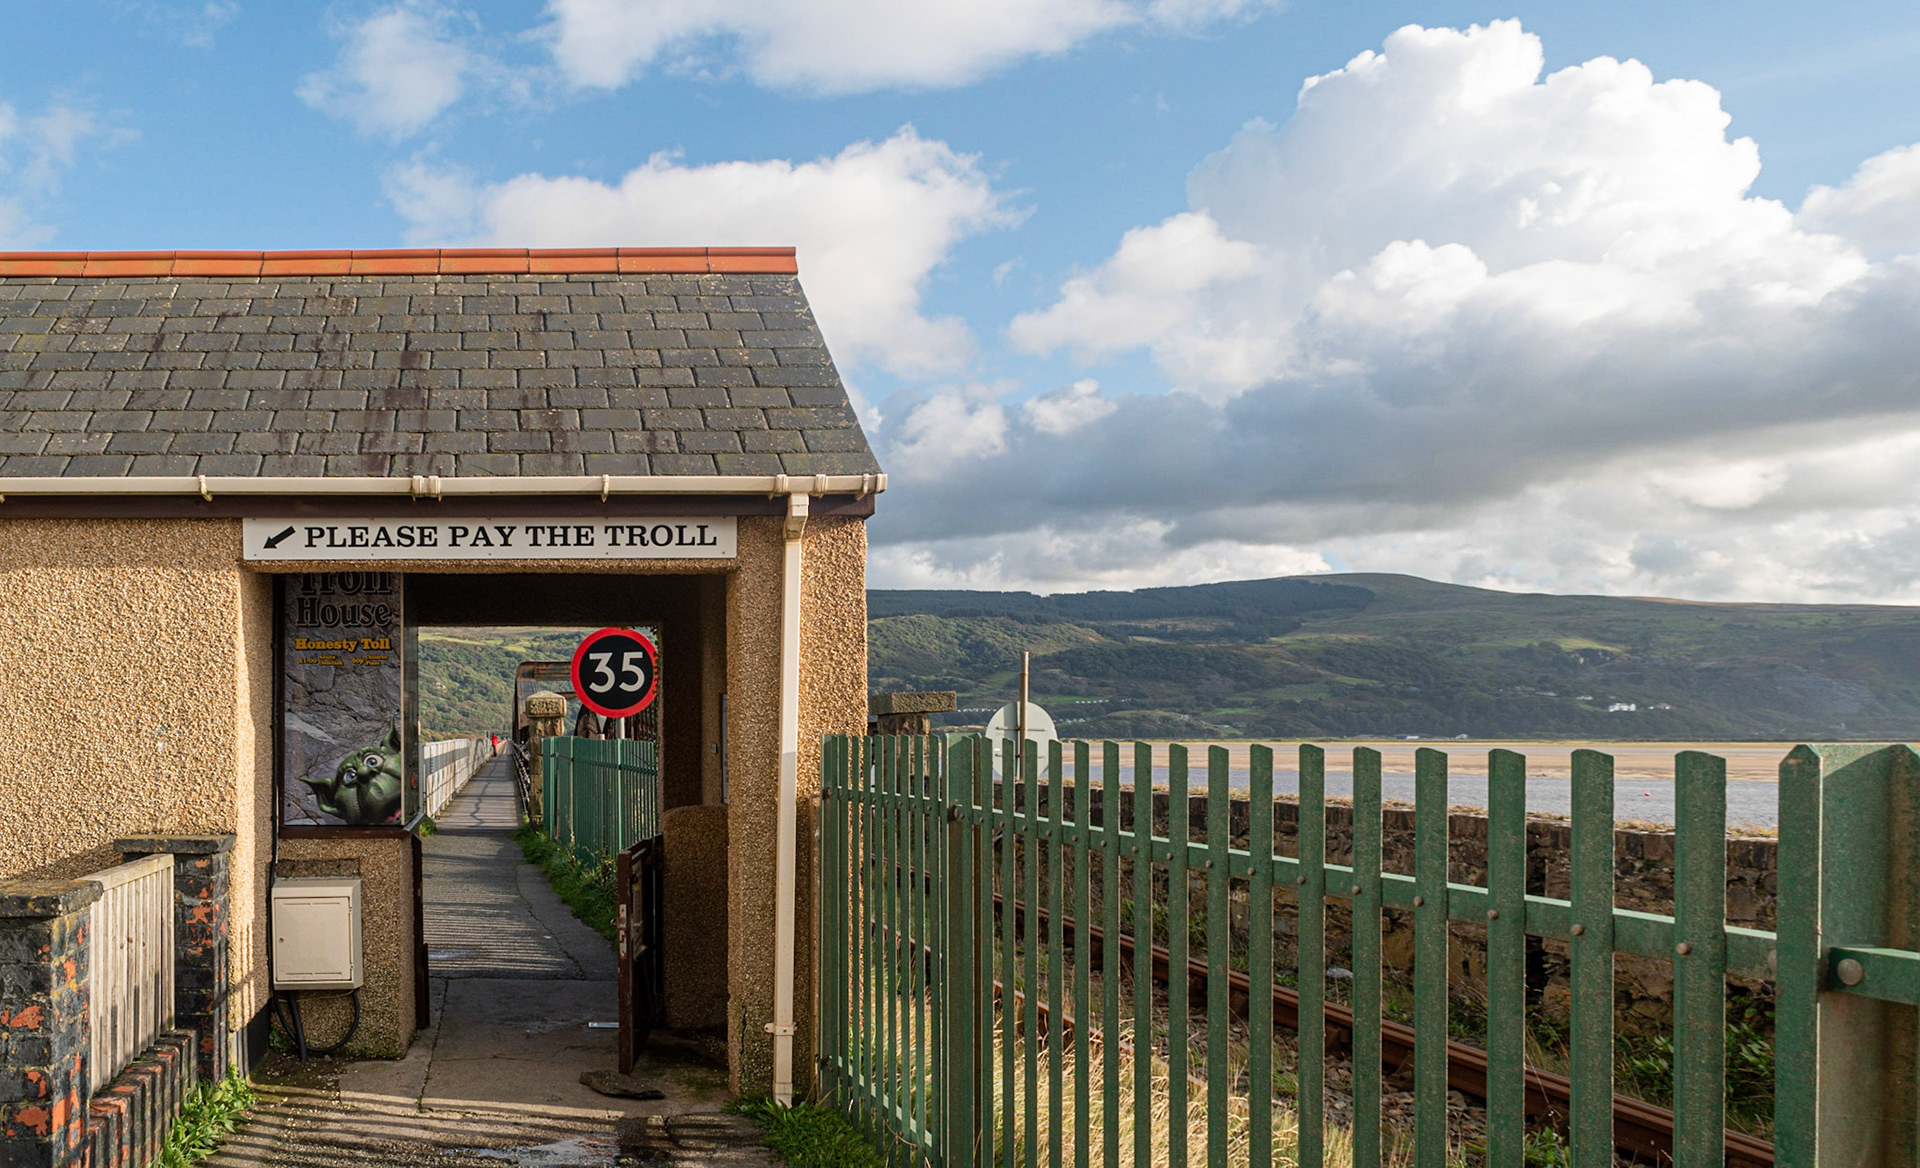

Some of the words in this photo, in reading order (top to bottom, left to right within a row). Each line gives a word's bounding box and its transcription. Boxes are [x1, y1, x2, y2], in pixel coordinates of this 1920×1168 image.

[304, 525, 438, 548] PLEASE
[448, 525, 517, 547] PAY
[525, 525, 595, 547] THE
[604, 524, 717, 547] TROLL
[296, 597, 392, 628] House
[294, 637, 358, 653] Honesty
[360, 637, 391, 650] Toll
[589, 651, 645, 693] 35
